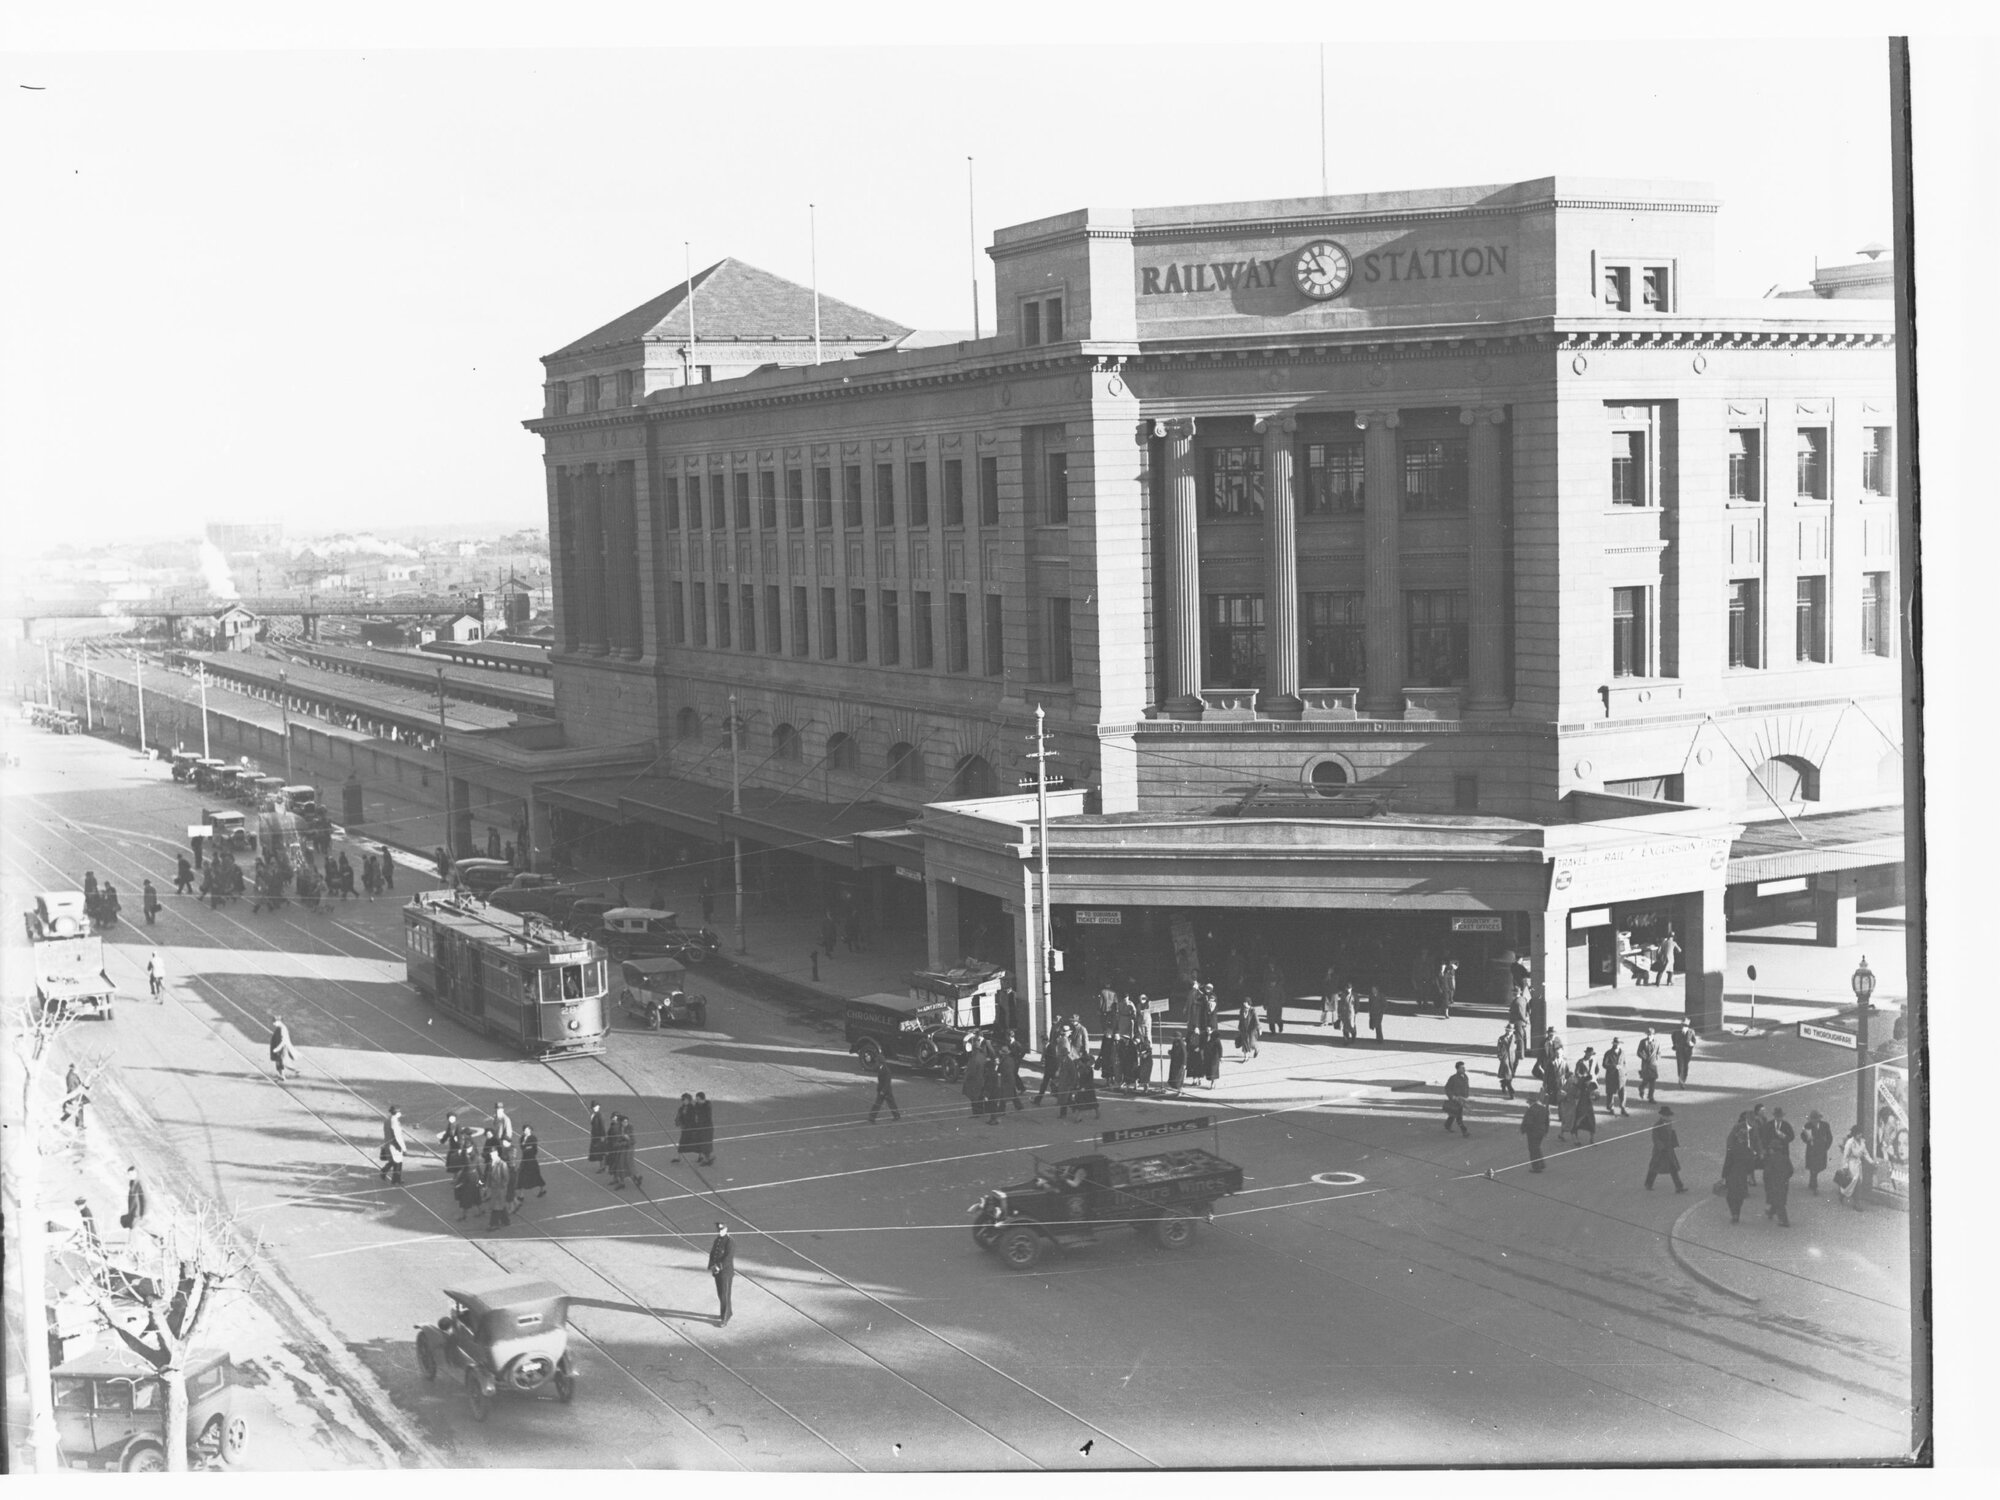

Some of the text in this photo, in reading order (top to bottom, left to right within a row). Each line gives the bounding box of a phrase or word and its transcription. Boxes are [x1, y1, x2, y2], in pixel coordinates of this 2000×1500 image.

[1142, 257, 1281, 295] RAILWAY
[1364, 245, 1510, 283] STATION
[1604, 851, 1625, 862] RAIL
[847, 1010, 894, 1025] CHRONICLE
[1804, 1027, 1852, 1044] NO THOROUGHFARE
[1115, 1122, 1198, 1140] Hardy's
[1178, 1177, 1225, 1194] Wines
